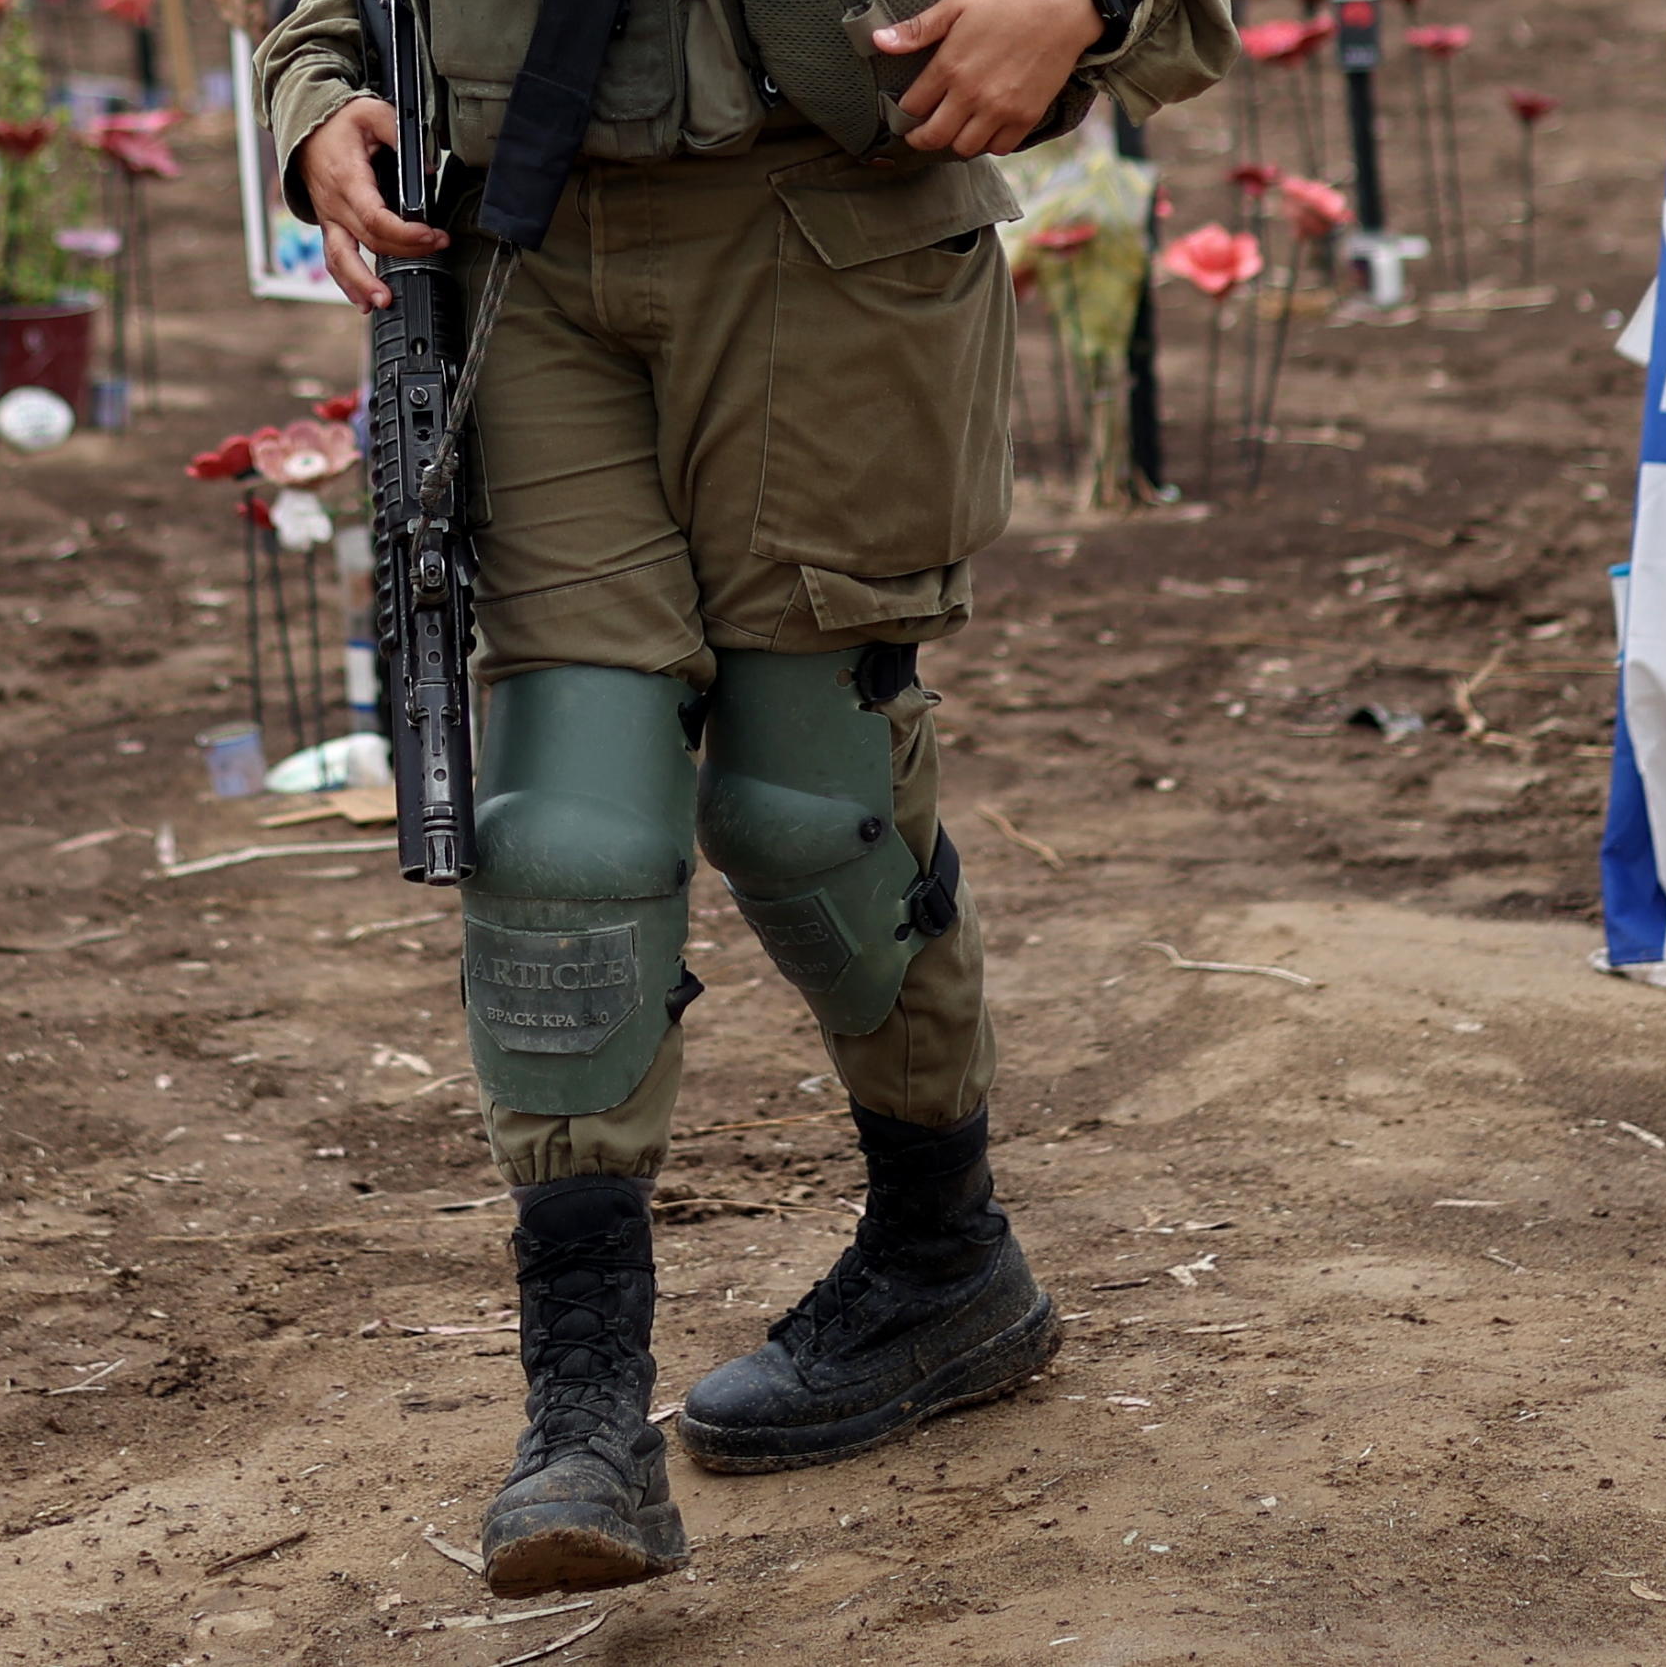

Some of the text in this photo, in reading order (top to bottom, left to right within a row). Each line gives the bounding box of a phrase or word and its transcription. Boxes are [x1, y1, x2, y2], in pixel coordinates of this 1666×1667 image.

[471, 953, 630, 991] ARTICLE
[487, 1007, 539, 1027] BPACK
[541, 1014, 578, 1028] KPA
